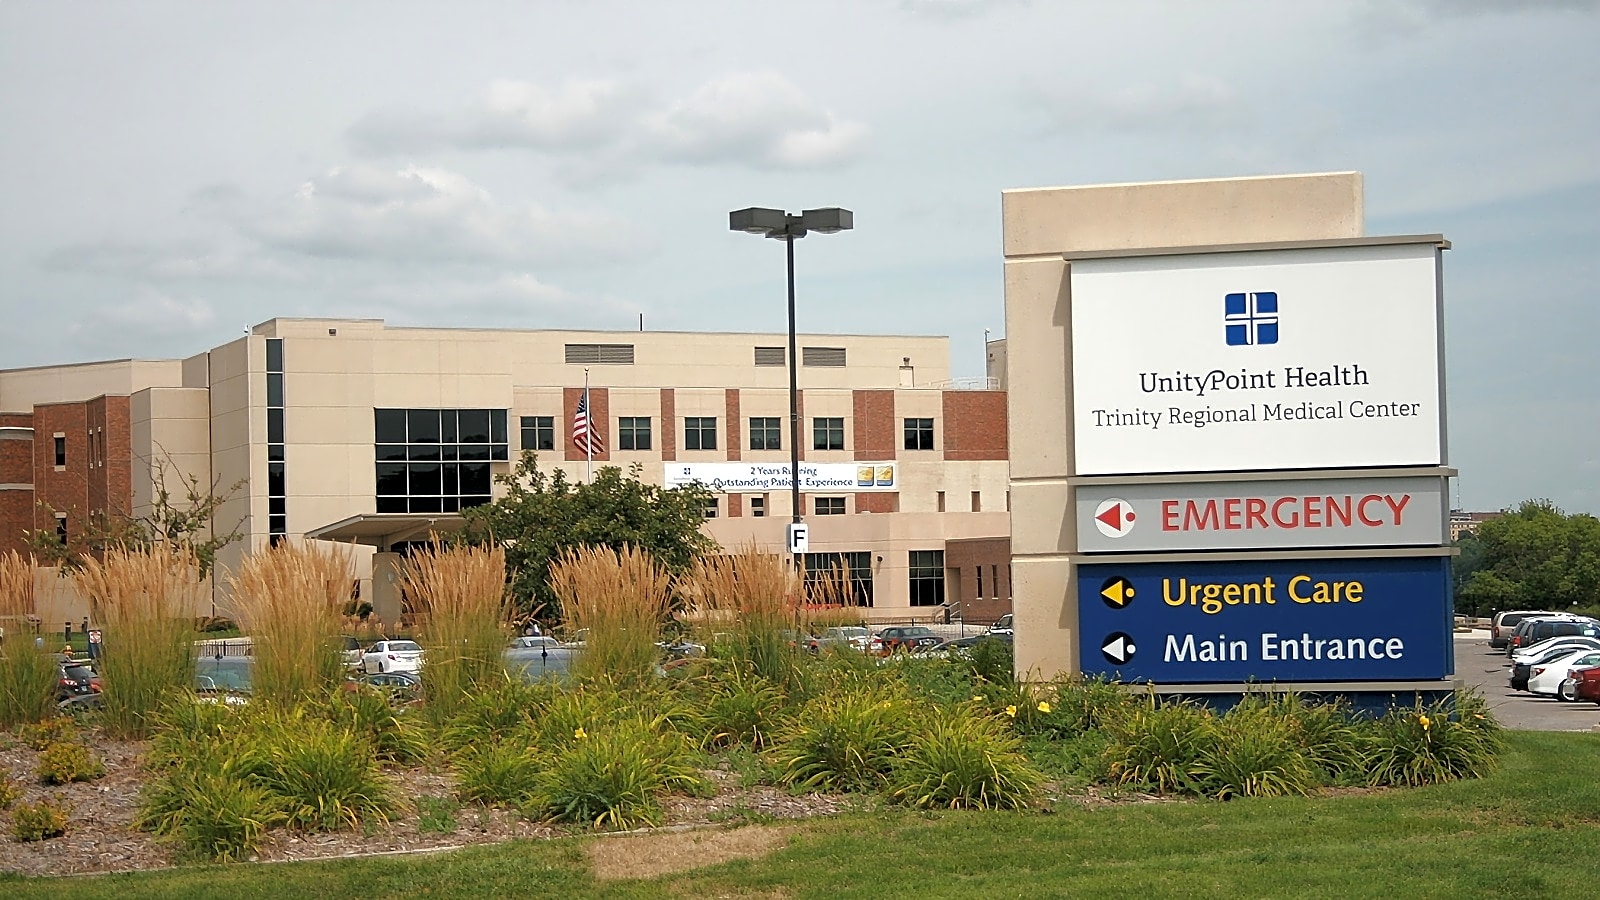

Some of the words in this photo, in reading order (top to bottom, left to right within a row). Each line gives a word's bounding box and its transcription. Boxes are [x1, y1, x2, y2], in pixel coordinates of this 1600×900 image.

[1140, 369, 1277, 396] UnityPoint
[1284, 364, 1369, 388] Health
[1092, 408, 1162, 430] Trinity
[1168, 405, 1257, 428] Regional
[1263, 401, 1344, 422] Medical
[1349, 400, 1421, 417] Center
[713, 477, 769, 488] Outstanding
[770, 477, 802, 487] Patiet
[805, 477, 853, 487] Experience
[750, 466, 756, 475] 2
[757, 466, 780, 476] Years
[781, 466, 818, 477] Runing
[1161, 493, 1411, 532] EMERGENCY
[793, 529, 806, 548] F
[1162, 576, 1276, 615] Urgent
[1287, 575, 1364, 604] Care
[1163, 634, 1248, 663] Main
[1261, 632, 1404, 662] Entrance
